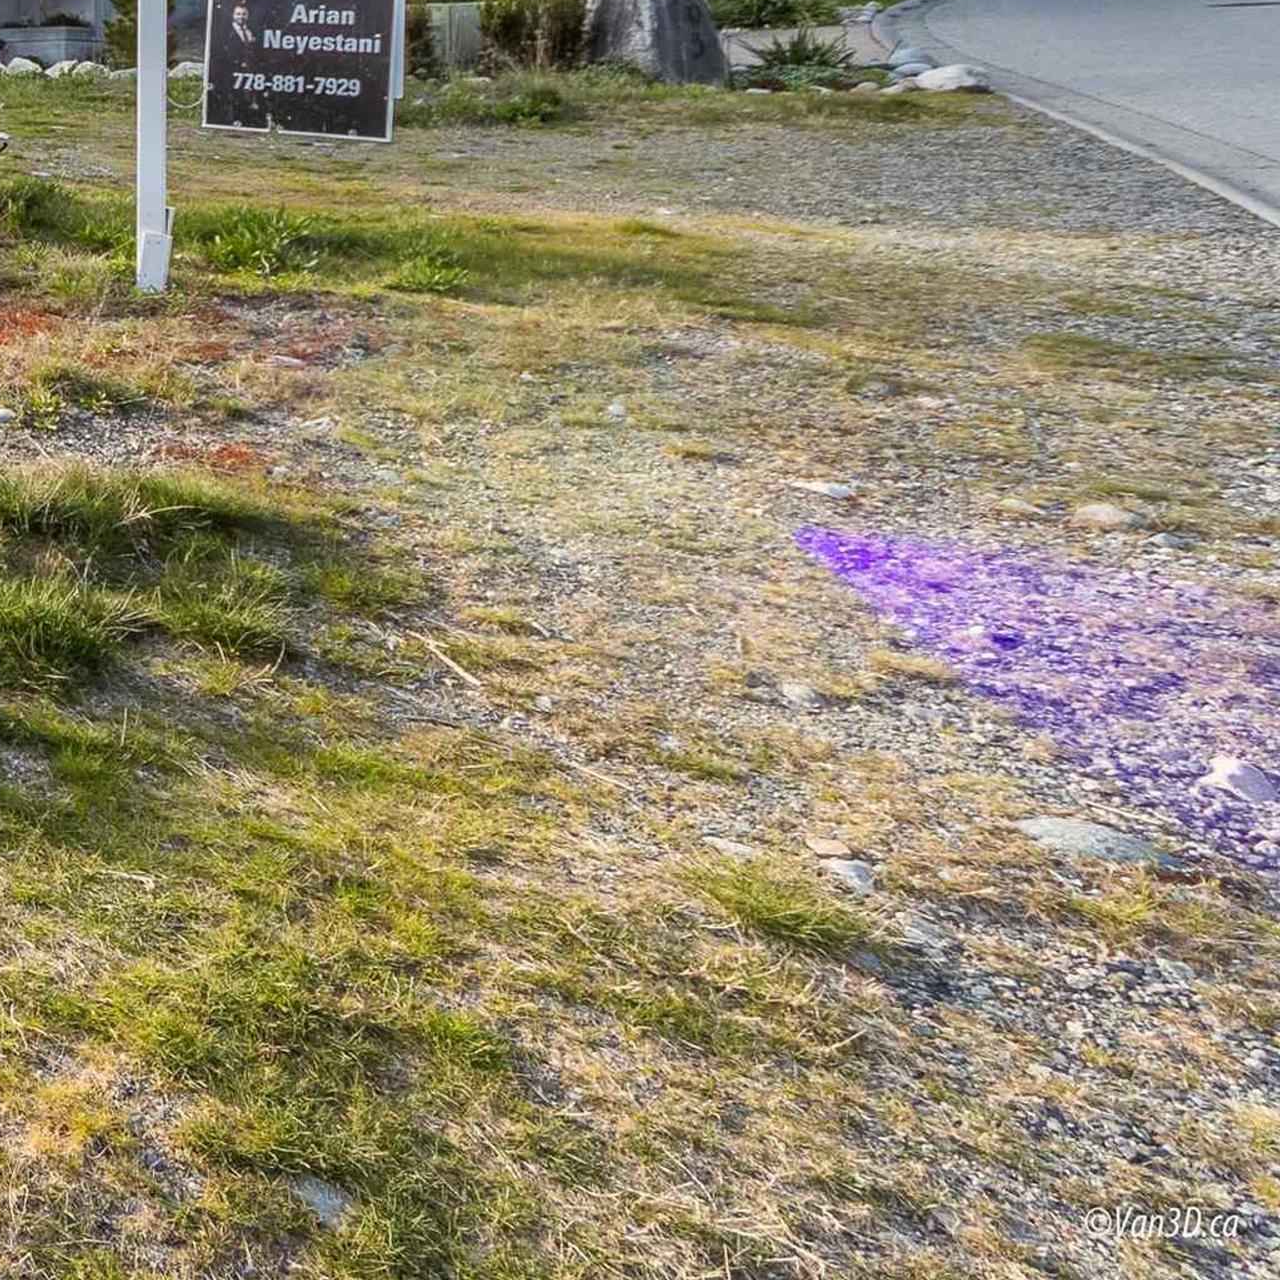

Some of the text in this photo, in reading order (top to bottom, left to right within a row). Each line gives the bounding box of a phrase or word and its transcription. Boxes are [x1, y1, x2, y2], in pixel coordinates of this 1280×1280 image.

[290, 4, 355, 25] Arian
[263, 29, 381, 54] Neyestani
[233, 73, 360, 96] 778-881-7929
